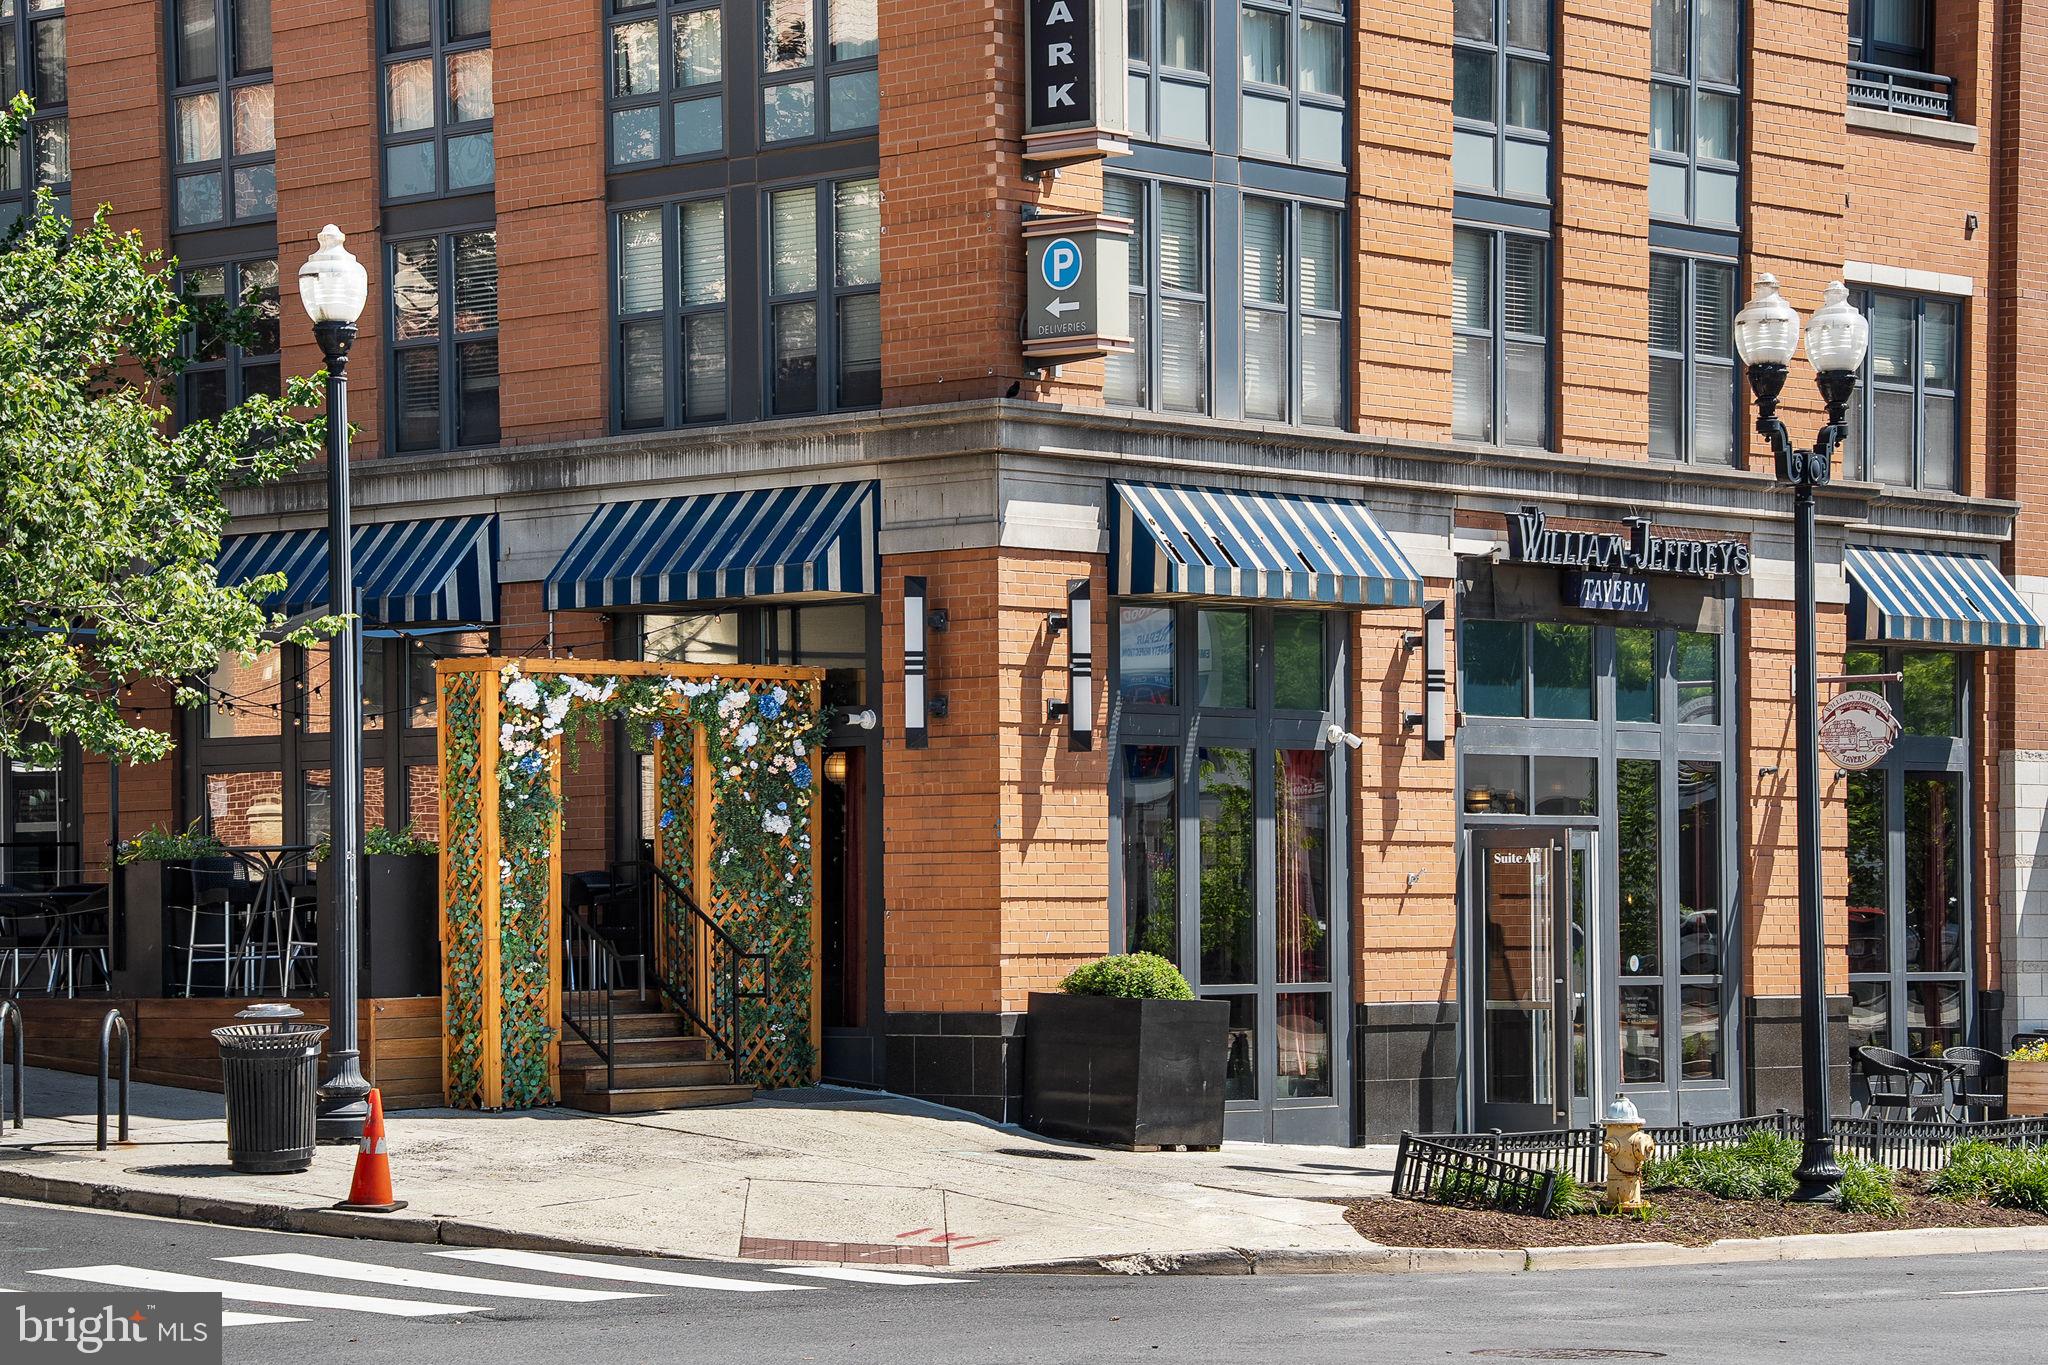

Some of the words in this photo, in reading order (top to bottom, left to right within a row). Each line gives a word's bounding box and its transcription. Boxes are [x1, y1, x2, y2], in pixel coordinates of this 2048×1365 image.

[1053, 248, 1074, 282] P
[1038, 321, 1087, 335] DELIVERIES
[1516, 511, 1628, 570] WILLIAM
[1583, 578, 1646, 606] TAVERN
[1841, 754, 1868, 763] TAVERN
[1493, 852, 1523, 864] Suite
